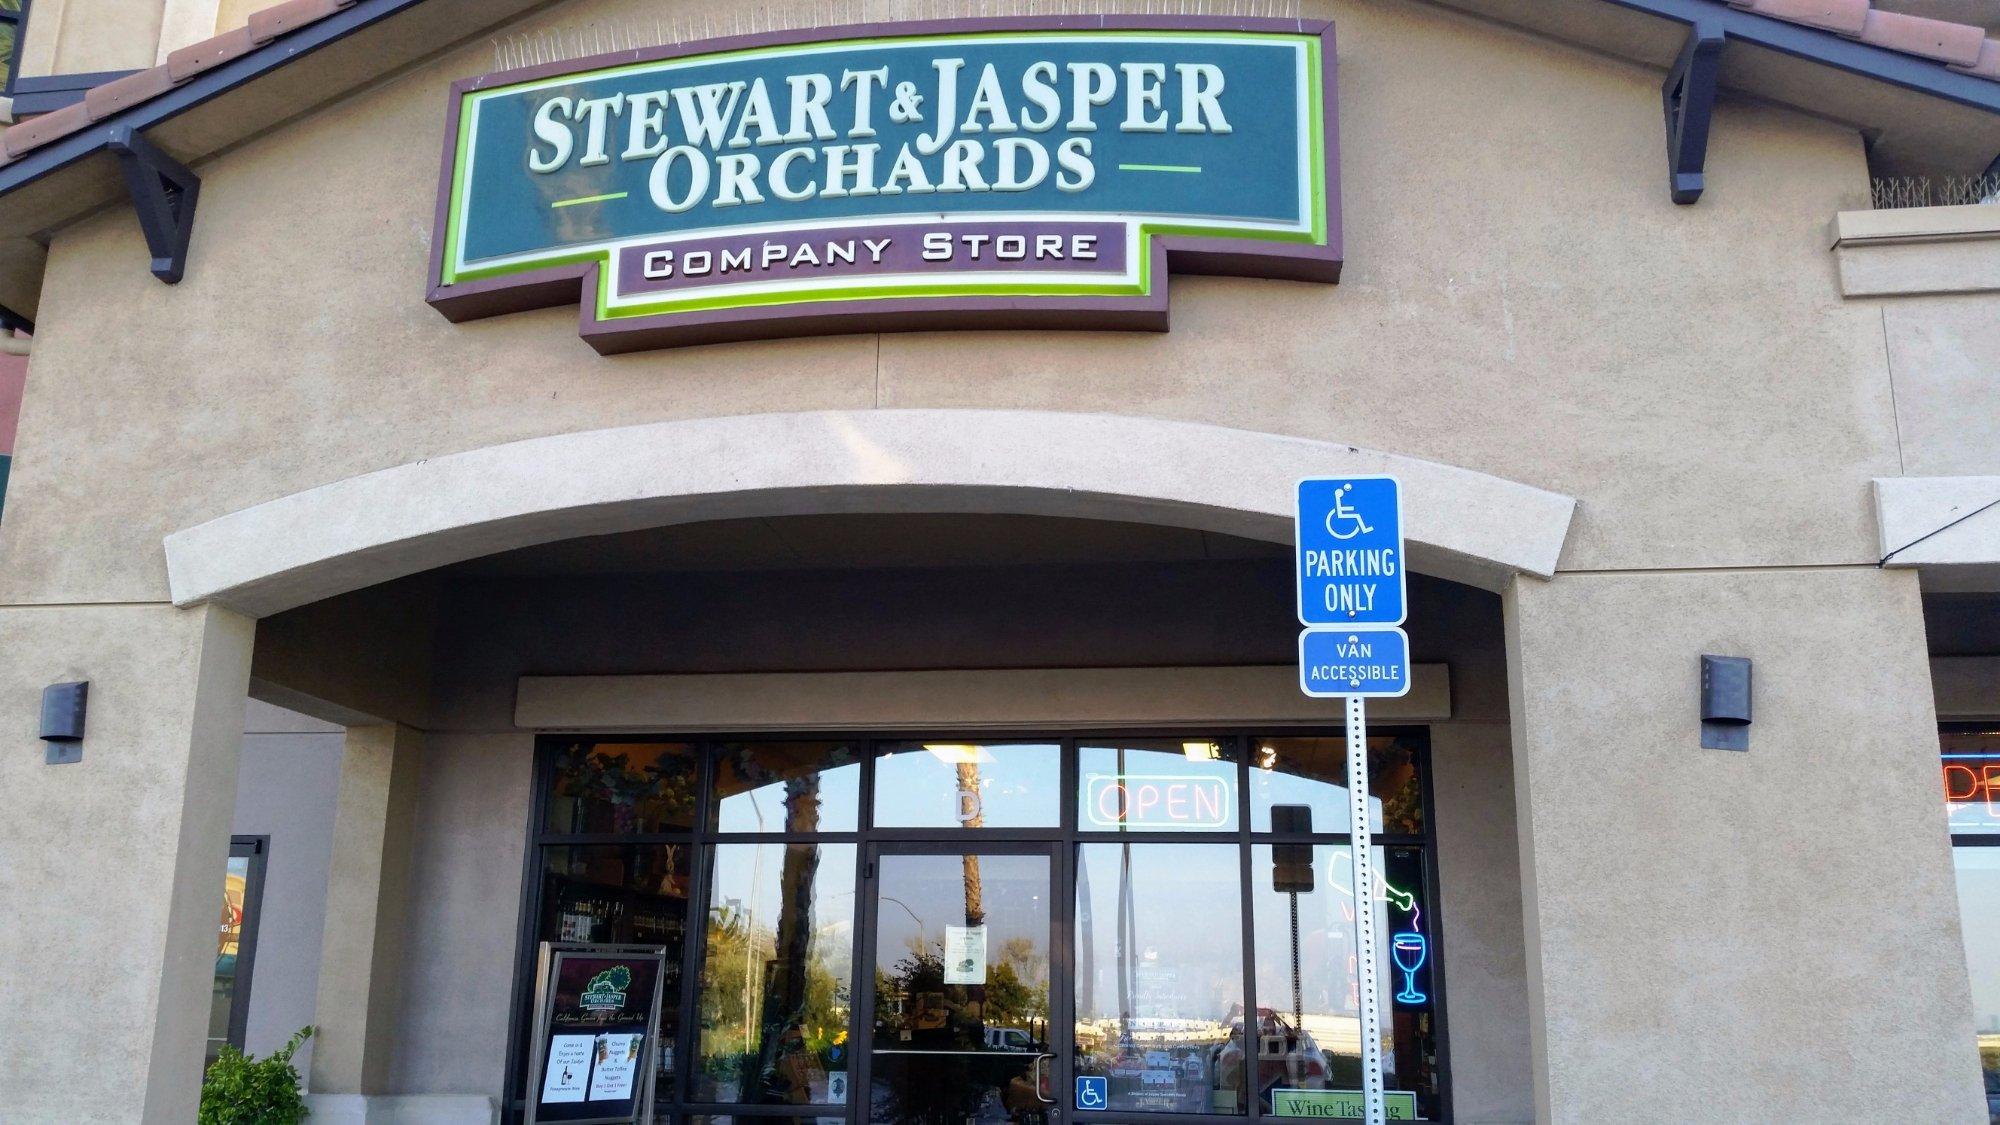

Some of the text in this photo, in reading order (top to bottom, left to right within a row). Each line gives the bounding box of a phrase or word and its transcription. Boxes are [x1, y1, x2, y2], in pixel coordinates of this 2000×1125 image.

[529, 57, 1233, 173] STEWART & JASPER
[649, 136, 1096, 213] ORCHARDS
[643, 232, 1097, 279] COMPANY STORE
[1306, 548, 1395, 577] PARKING
[1325, 583, 1377, 612] ONLY
[1336, 643, 1372, 658] VAN
[1311, 665, 1400, 681] ACCESSIBLE
[956, 790, 980, 822] D
[1100, 784, 1219, 820] OPEN
[1942, 765, 2000, 818] PE
[1288, 1100, 1401, 1120] Wine Tasg
